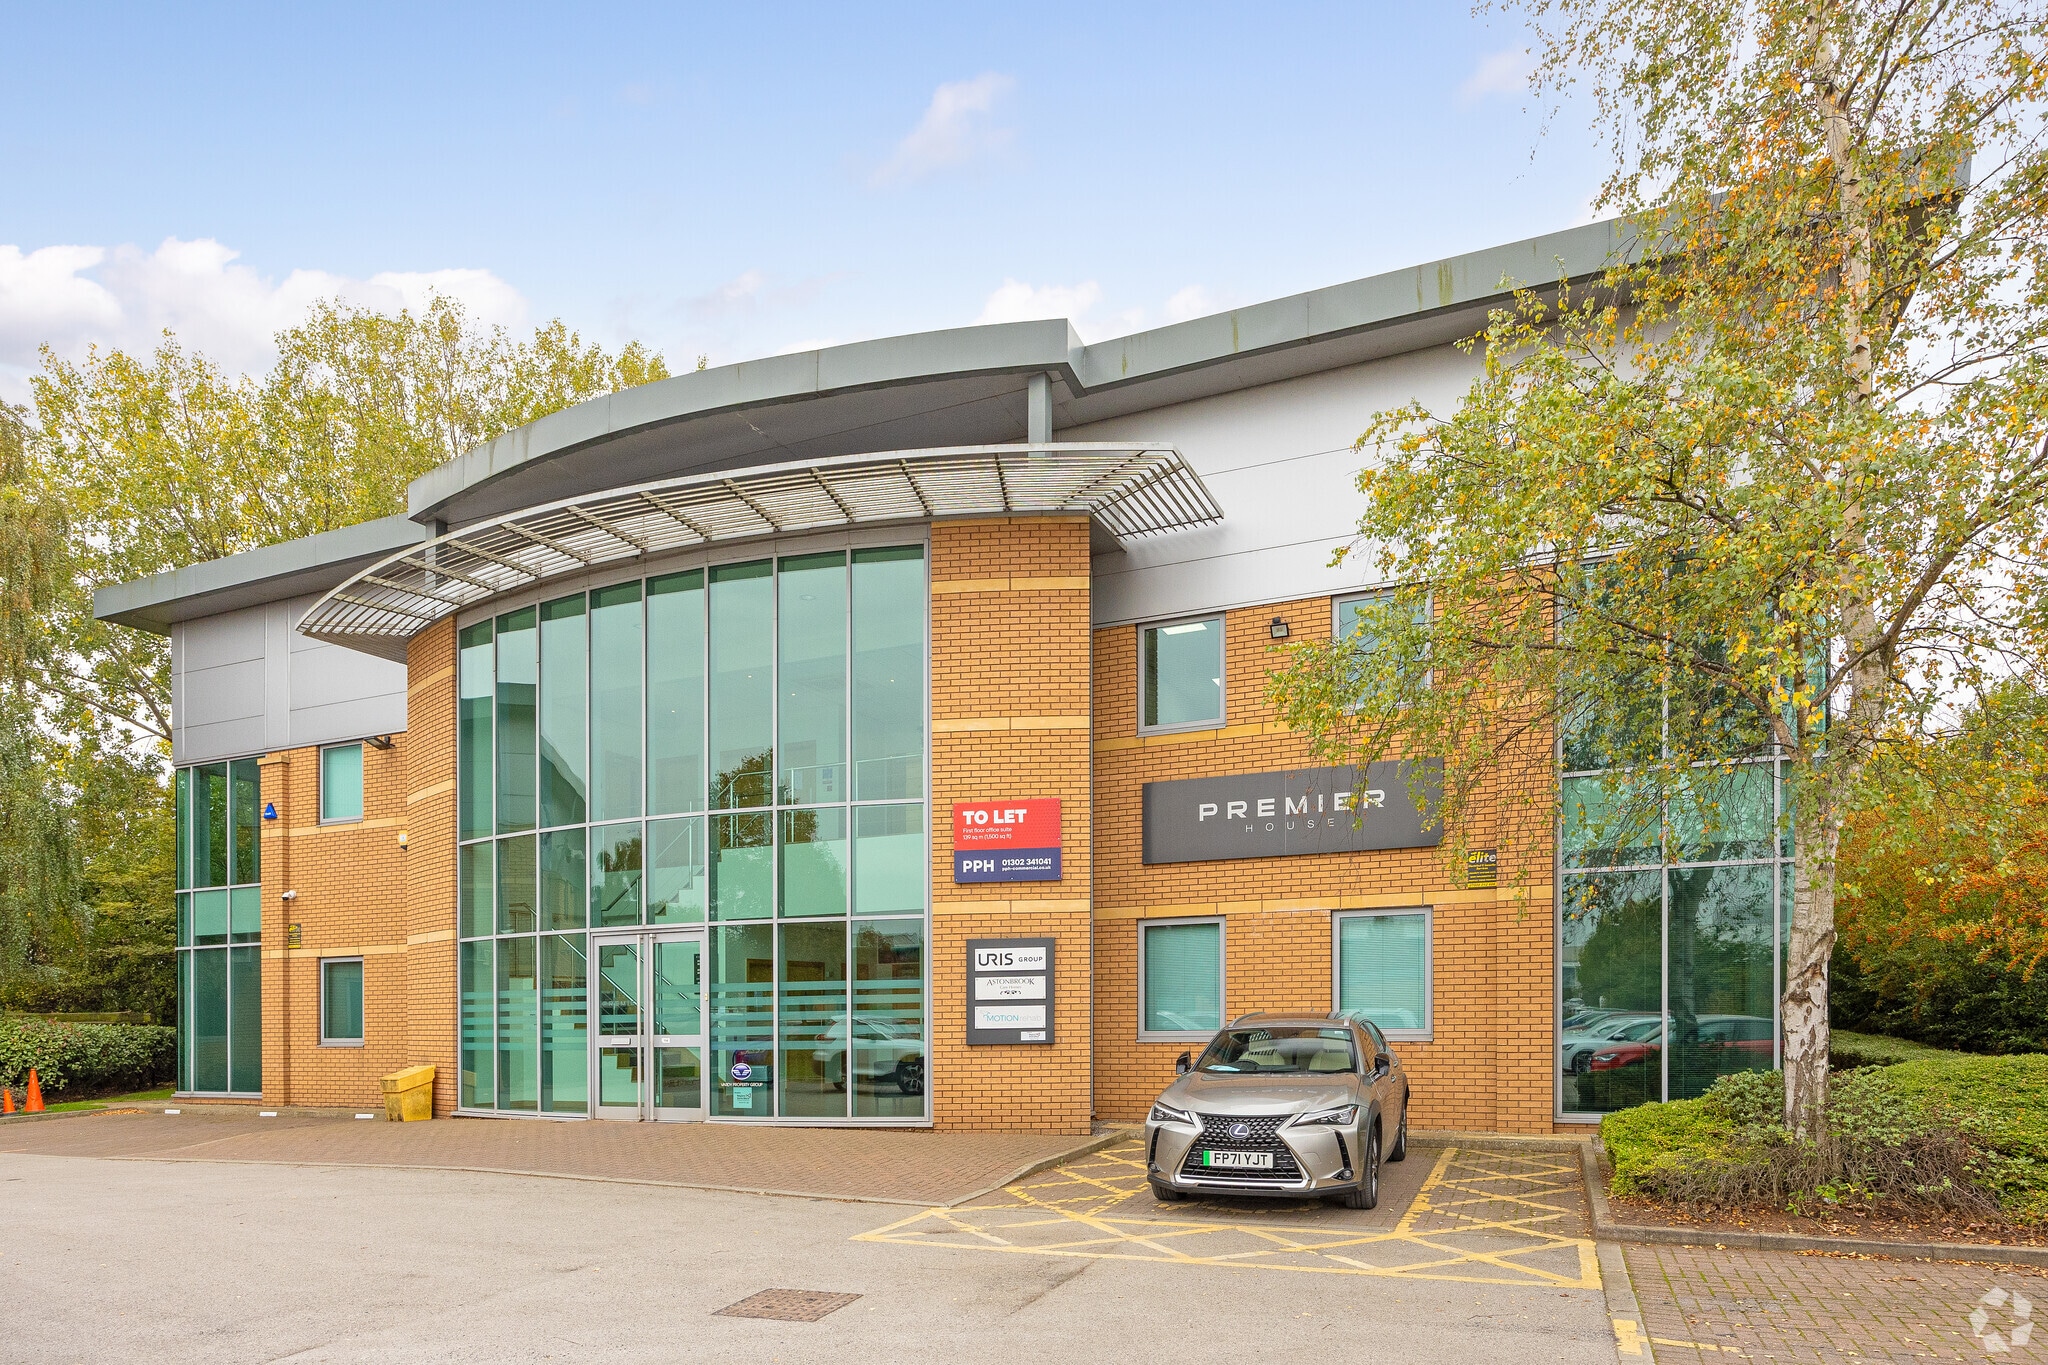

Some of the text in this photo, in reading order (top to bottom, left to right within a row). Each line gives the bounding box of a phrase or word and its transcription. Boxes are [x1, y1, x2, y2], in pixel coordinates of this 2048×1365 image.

[962, 809, 1027, 825] TO LET
[1199, 789, 1386, 833] PREMIER HOUSE
[962, 859, 995, 873] PPH
[1002, 857, 1052, 866] 01302 341041
[978, 953, 1014, 966] URIS
[1214, 1152, 1268, 1166] FP71 YJT
